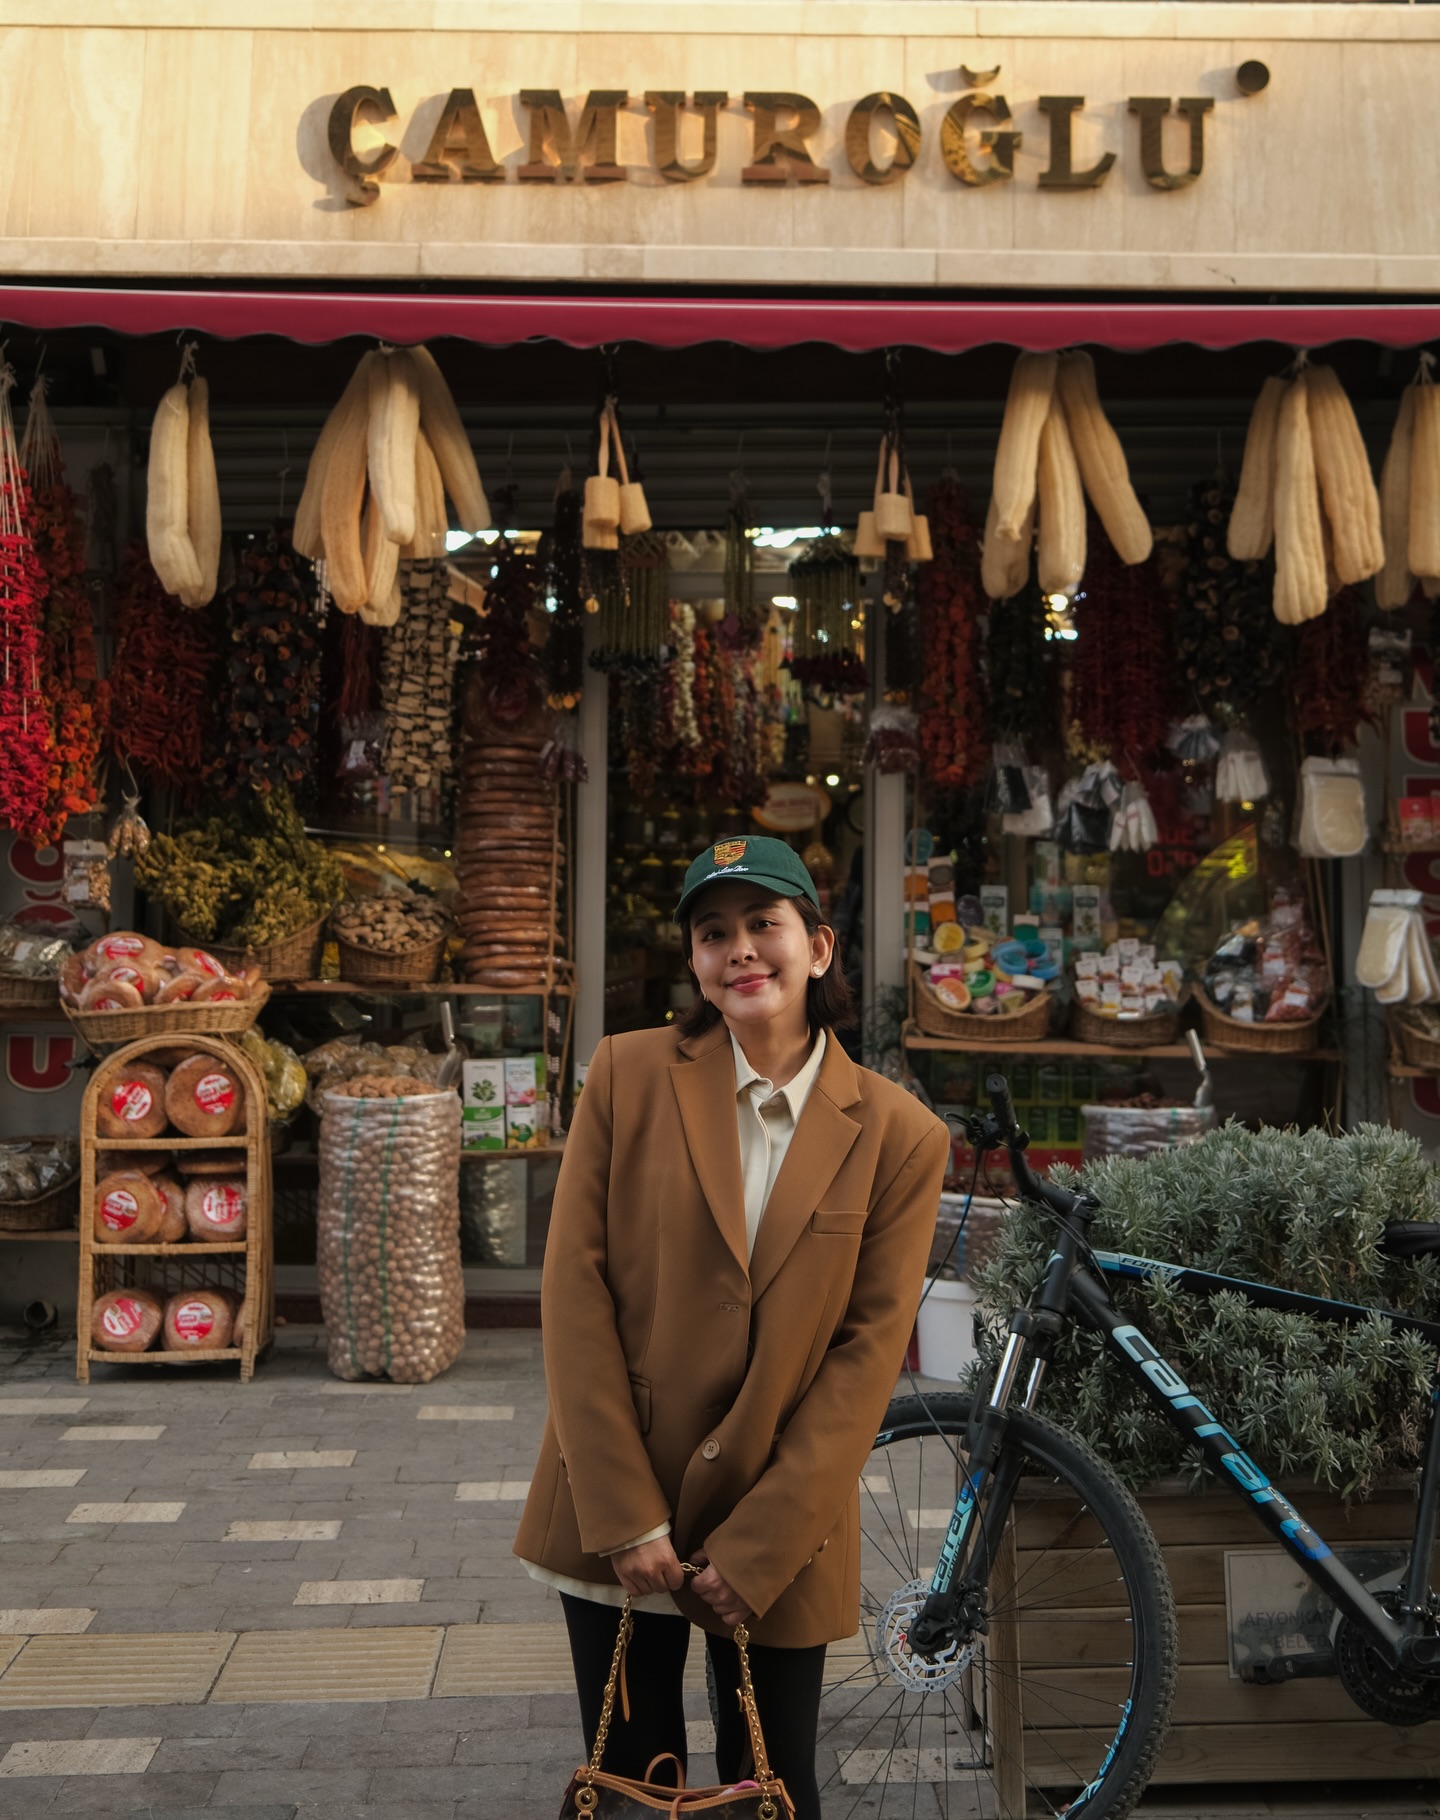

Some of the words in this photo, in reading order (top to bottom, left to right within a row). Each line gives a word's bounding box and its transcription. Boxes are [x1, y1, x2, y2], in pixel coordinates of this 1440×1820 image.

[328, 64, 1213, 204] ÇAMUROĞLU
[1121, 1258, 1178, 1275] FORCE
[1243, 1610, 1333, 1627] AFYONKAR
[1274, 1634, 1327, 1649] BELED
